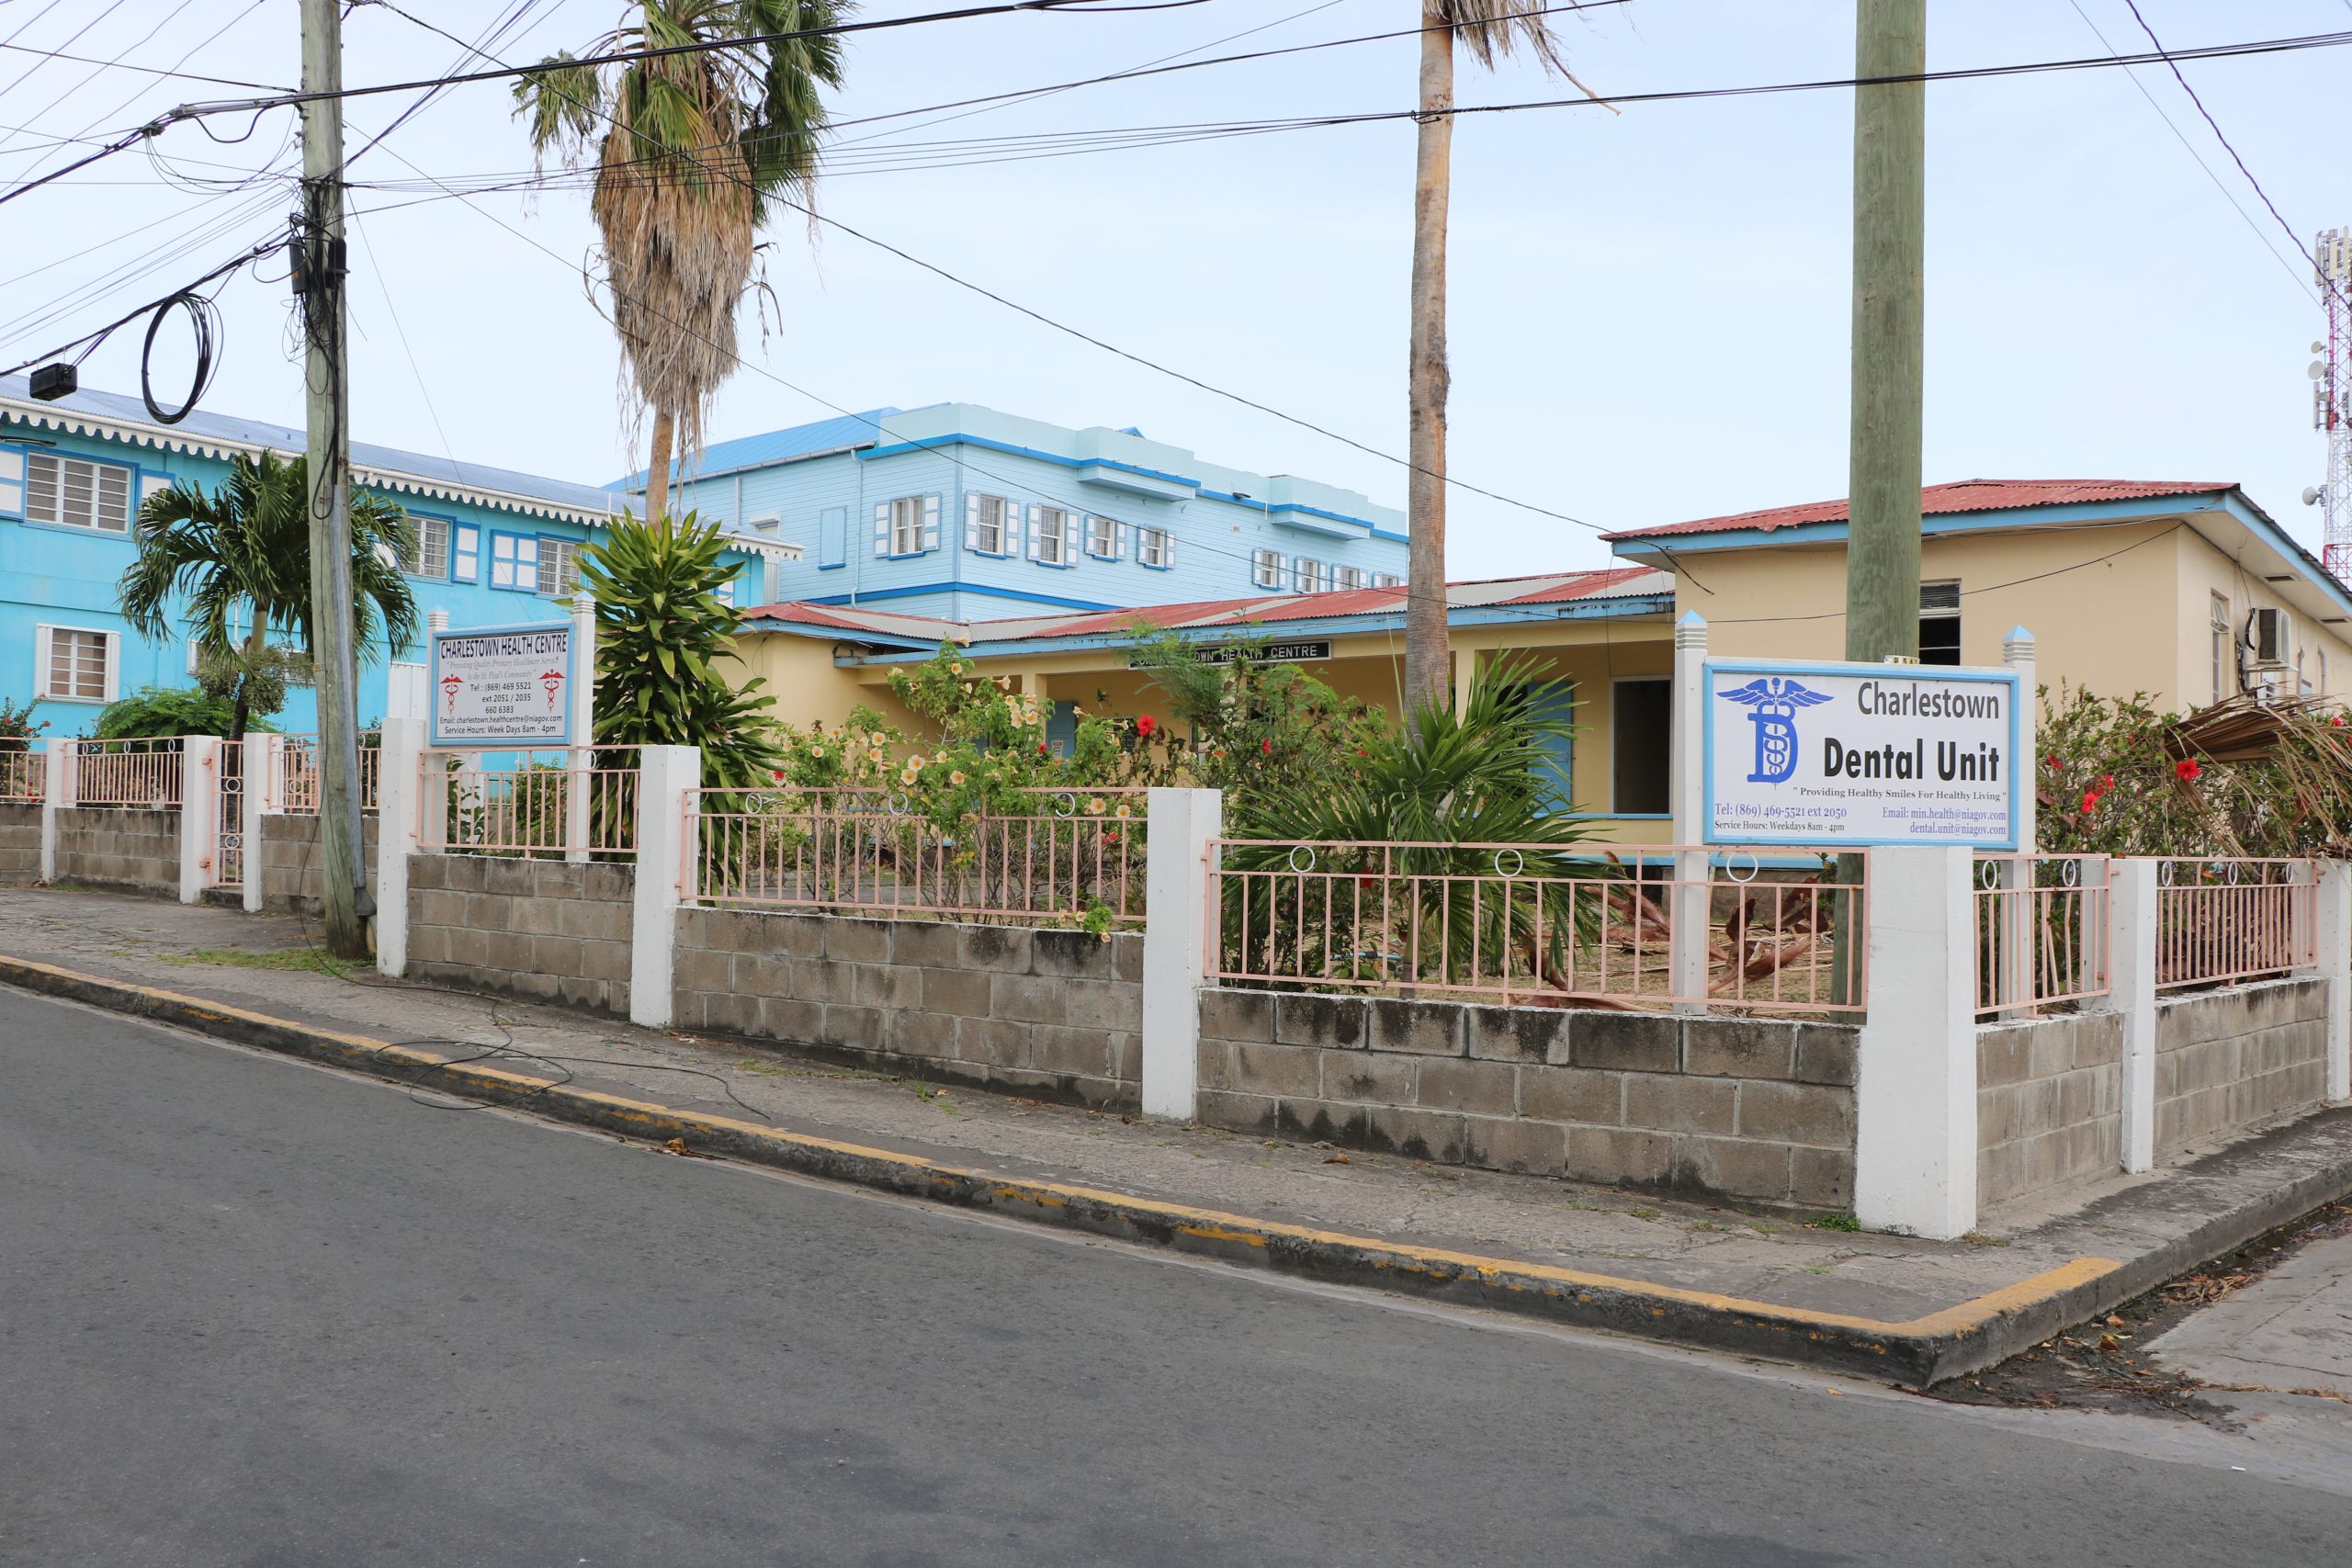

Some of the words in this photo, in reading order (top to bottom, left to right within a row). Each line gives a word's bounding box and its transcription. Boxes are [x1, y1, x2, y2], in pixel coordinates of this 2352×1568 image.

[441, 638, 499, 659] CHARLESTOWN
[502, 637, 533, 656] HEALTH
[535, 635, 567, 654] CENTRE
[1271, 646, 1317, 659] CENTRE
[484, 682, 501, 692] (869)
[502, 682, 514, 691] 469
[515, 682, 531, 690] 5521
[493, 694, 509, 703] 2051
[515, 694, 531, 702] 2035
[1858, 682, 1999, 719] Charlestown
[498, 705, 514, 714] 6383
[445, 726, 465, 734] Service
[467, 726, 486, 734] Hours:
[487, 725, 504, 733] Week
[505, 726, 520, 735] Days
[522, 725, 536, 733] 8am
[541, 725, 556, 735] 4pm
[1824, 737, 1924, 780] Dental
[1937, 740, 1999, 782] Unit
[1800, 787, 1845, 798] Providing
[1848, 788, 1883, 799] Healthy
[1885, 789, 1916, 798] Smiles
[1917, 791, 1934, 799] For
[1936, 791, 1970, 801] Healthy
[1973, 792, 2001, 802] Living
[1715, 803, 1733, 816] Tel:
[1736, 803, 1761, 818] (869)
[1763, 805, 1805, 819] 469-5521
[1807, 807, 1822, 817] ext
[1824, 807, 1847, 819] 2050
[1883, 807, 1909, 819] Email:
[1910, 807, 2007, 823] min.health@niagov.com
[1714, 820, 1741, 829] Service
[1743, 820, 1768, 830] Hours:
[1770, 821, 1805, 832] Weekdays
[1807, 822, 1823, 831] 8am
[1828, 824, 1845, 833] 4pm
[1910, 822, 2007, 837] dental.unit@niagov.com
